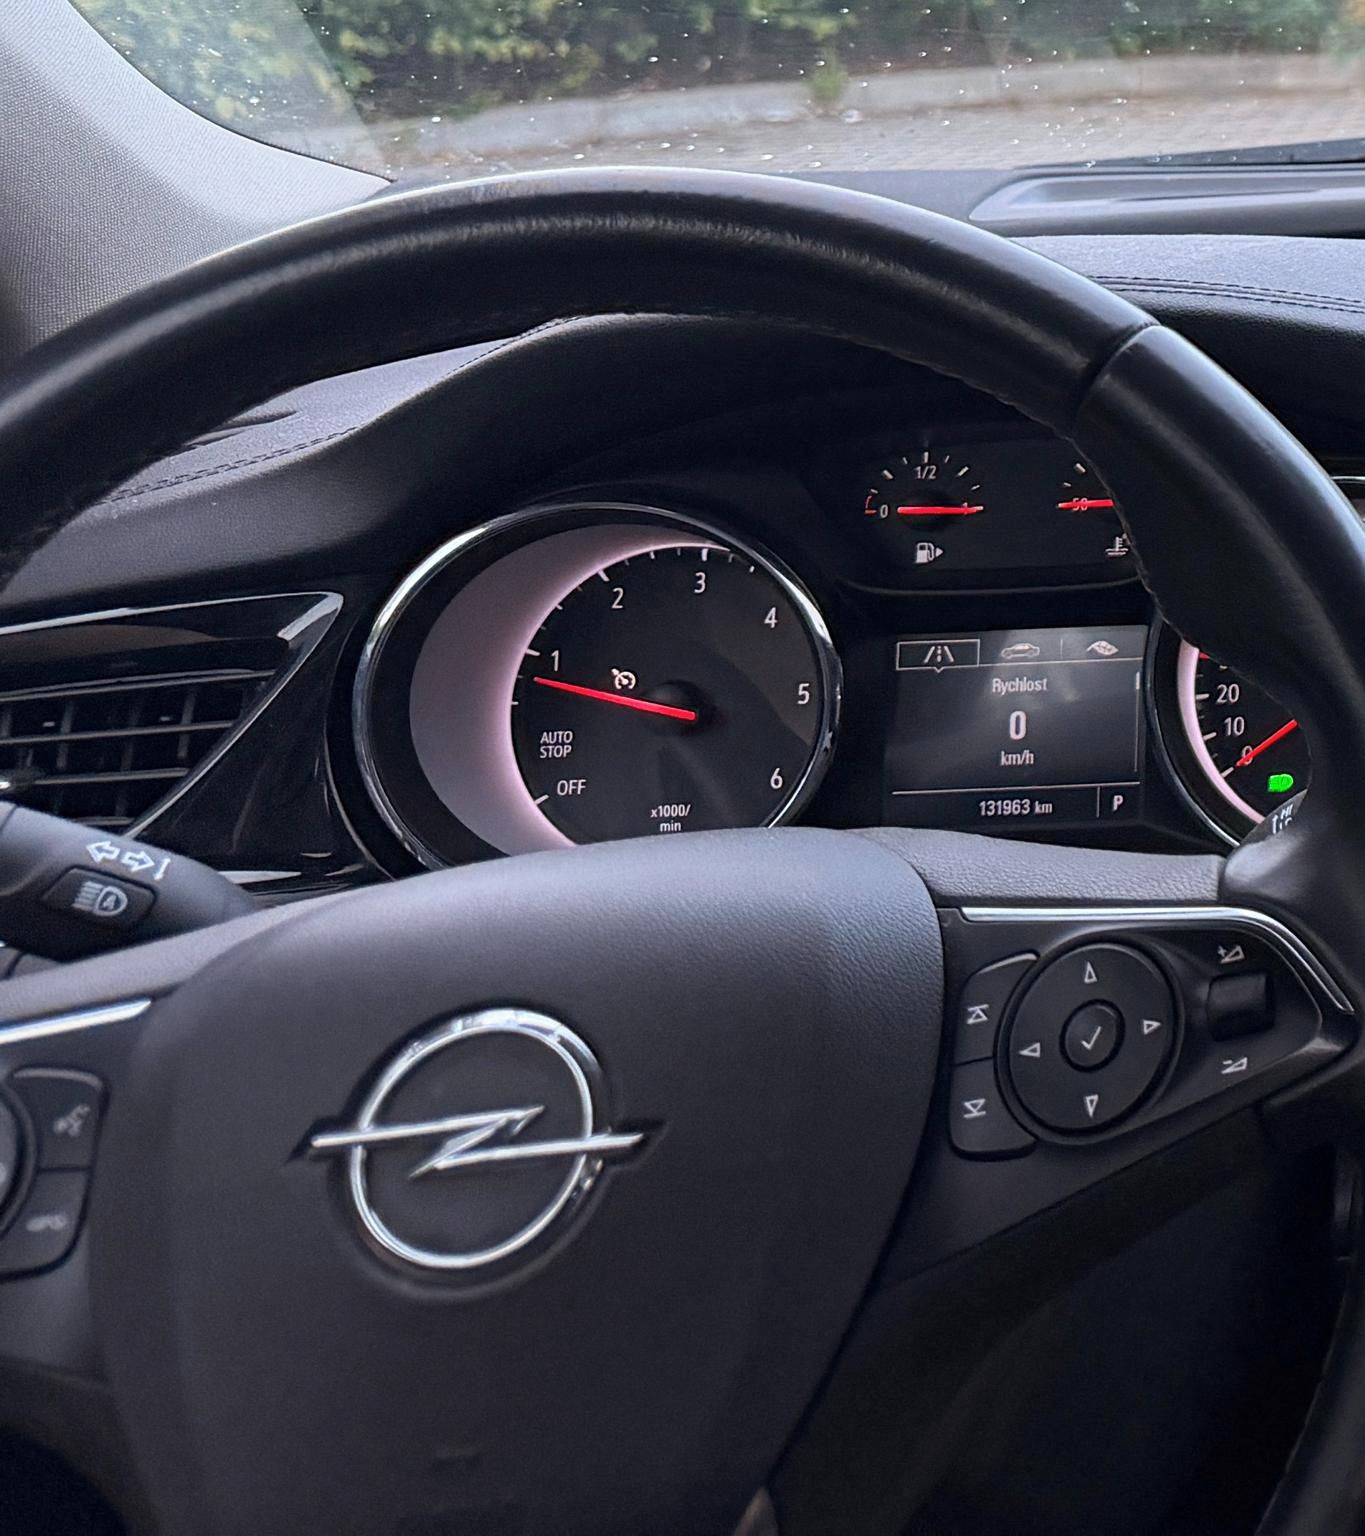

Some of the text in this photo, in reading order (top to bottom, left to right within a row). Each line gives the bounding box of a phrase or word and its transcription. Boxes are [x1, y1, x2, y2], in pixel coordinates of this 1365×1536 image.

[914, 465, 937, 480] 1/2
[879, 504, 889, 518] 0
[694, 572, 706, 594] 3
[611, 588, 624, 609] 2
[763, 607, 778, 629] 4
[550, 650, 560, 672] 1
[797, 683, 811, 705] 5
[991, 677, 1048, 695] Rychlost
[1216, 684, 1240, 704] 20
[1009, 710, 1027, 740] 0
[1224, 716, 1245, 736] 10
[540, 730, 573, 744] AUTO
[539, 745, 572, 759] STOP
[1000, 749, 1035, 766] km/h
[770, 768, 783, 789] 6
[557, 779, 587, 796] OFF
[650, 804, 691, 818] x1000/
[979, 799, 1053, 816] 131963 km
[1112, 795, 1124, 811] P
[660, 820, 681, 832] min
